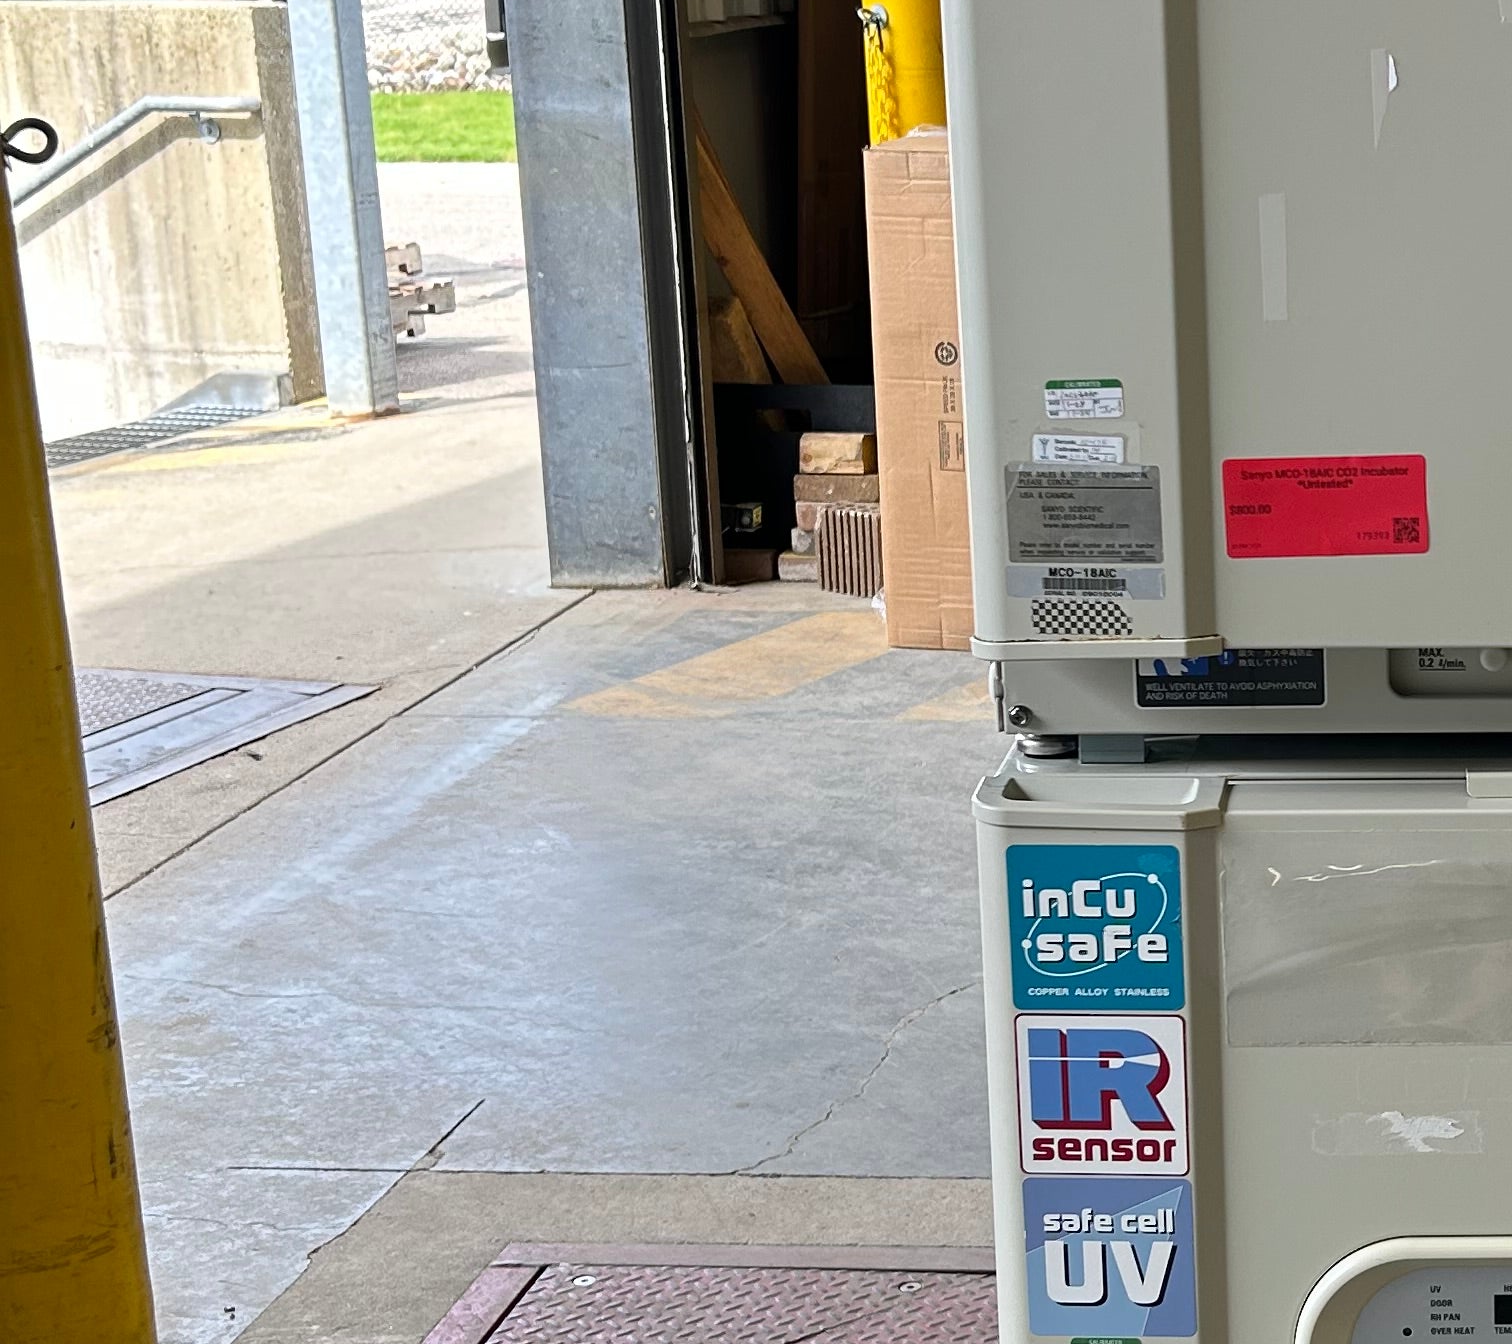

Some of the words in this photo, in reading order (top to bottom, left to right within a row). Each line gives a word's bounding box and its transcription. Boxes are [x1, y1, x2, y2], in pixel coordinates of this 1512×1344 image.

[1241, 469, 1273, 481] Sanyo
[1275, 468, 1334, 479] MCO-18AIC
[1336, 468, 1358, 478] CO2
[1360, 466, 1409, 476] Incubator
[1048, 568, 1117, 578] MCO-18AIC
[1418, 658, 1434, 668] 0.2
[1145, 683, 1168, 691] WELL
[1169, 683, 1216, 691] VENTILATE
[1217, 683, 1228, 691] TO
[1230, 682, 1256, 690] AVOID
[1257, 681, 1317, 690] ASPHYXIATION
[1145, 692, 1164, 700] AND
[1166, 692, 1185, 700] RISK
[1186, 692, 1198, 700] OF
[1200, 692, 1228, 700] DEATH
[1022, 878, 1136, 918] inCu
[1027, 988, 1069, 997] COPPER
[1075, 988, 1109, 997] ALLOY
[1114, 988, 1170, 997] STAINLESS
[1027, 1028, 1175, 1131] IR
[1032, 1137, 1177, 1162] sensor
[1043, 1208, 1114, 1233] safe
[1121, 1208, 1175, 1234] cell
[1044, 1240, 1177, 1307] UV
[1430, 1285, 1442, 1294] UV
[1430, 1299, 1453, 1307] DOOR
[1443, 1313, 1461, 1321] PAN
[1430, 1327, 1452, 1335] OVER
[1454, 1327, 1475, 1335] HEAT
